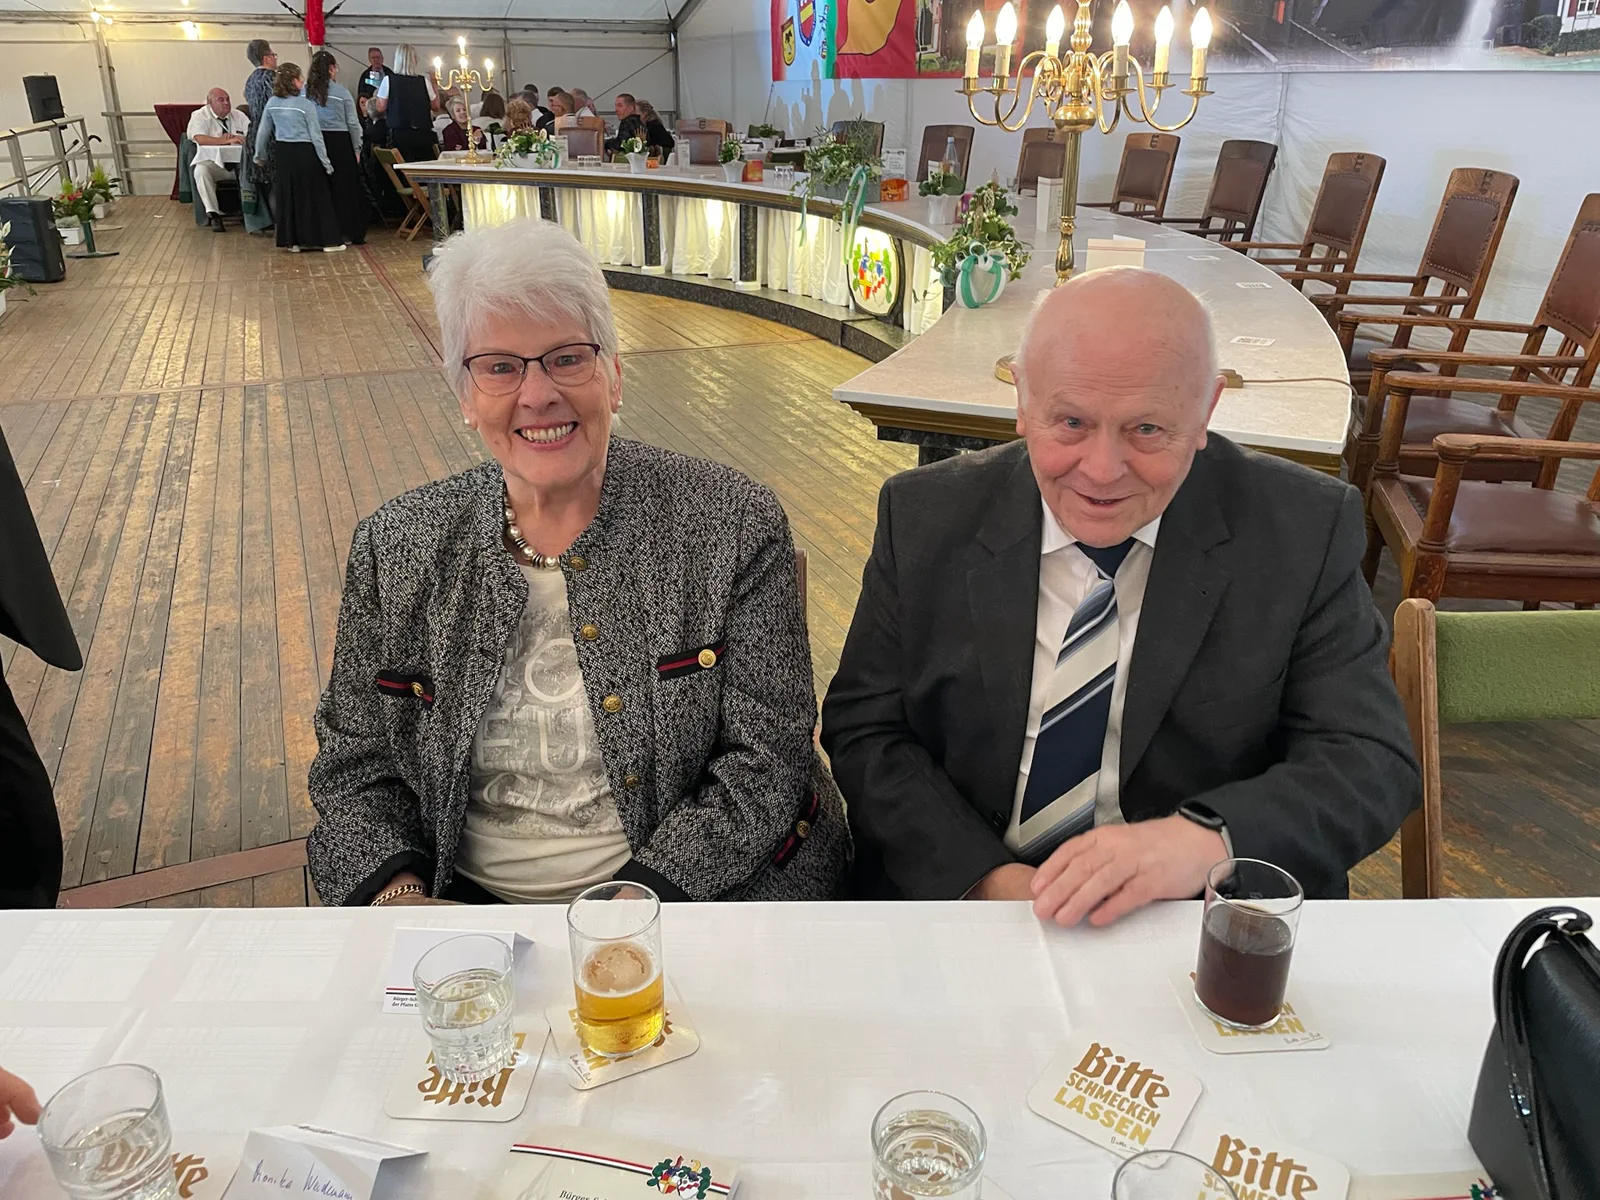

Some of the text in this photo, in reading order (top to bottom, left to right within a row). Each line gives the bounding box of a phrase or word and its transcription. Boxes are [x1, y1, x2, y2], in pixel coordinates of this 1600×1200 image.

[1065, 1072, 1161, 1128] SCHMECKEN
[1073, 1042, 1170, 1109] Bitte
[1053, 1086, 1152, 1146] LASSEN
[1211, 1133, 1318, 1200] Bitte
